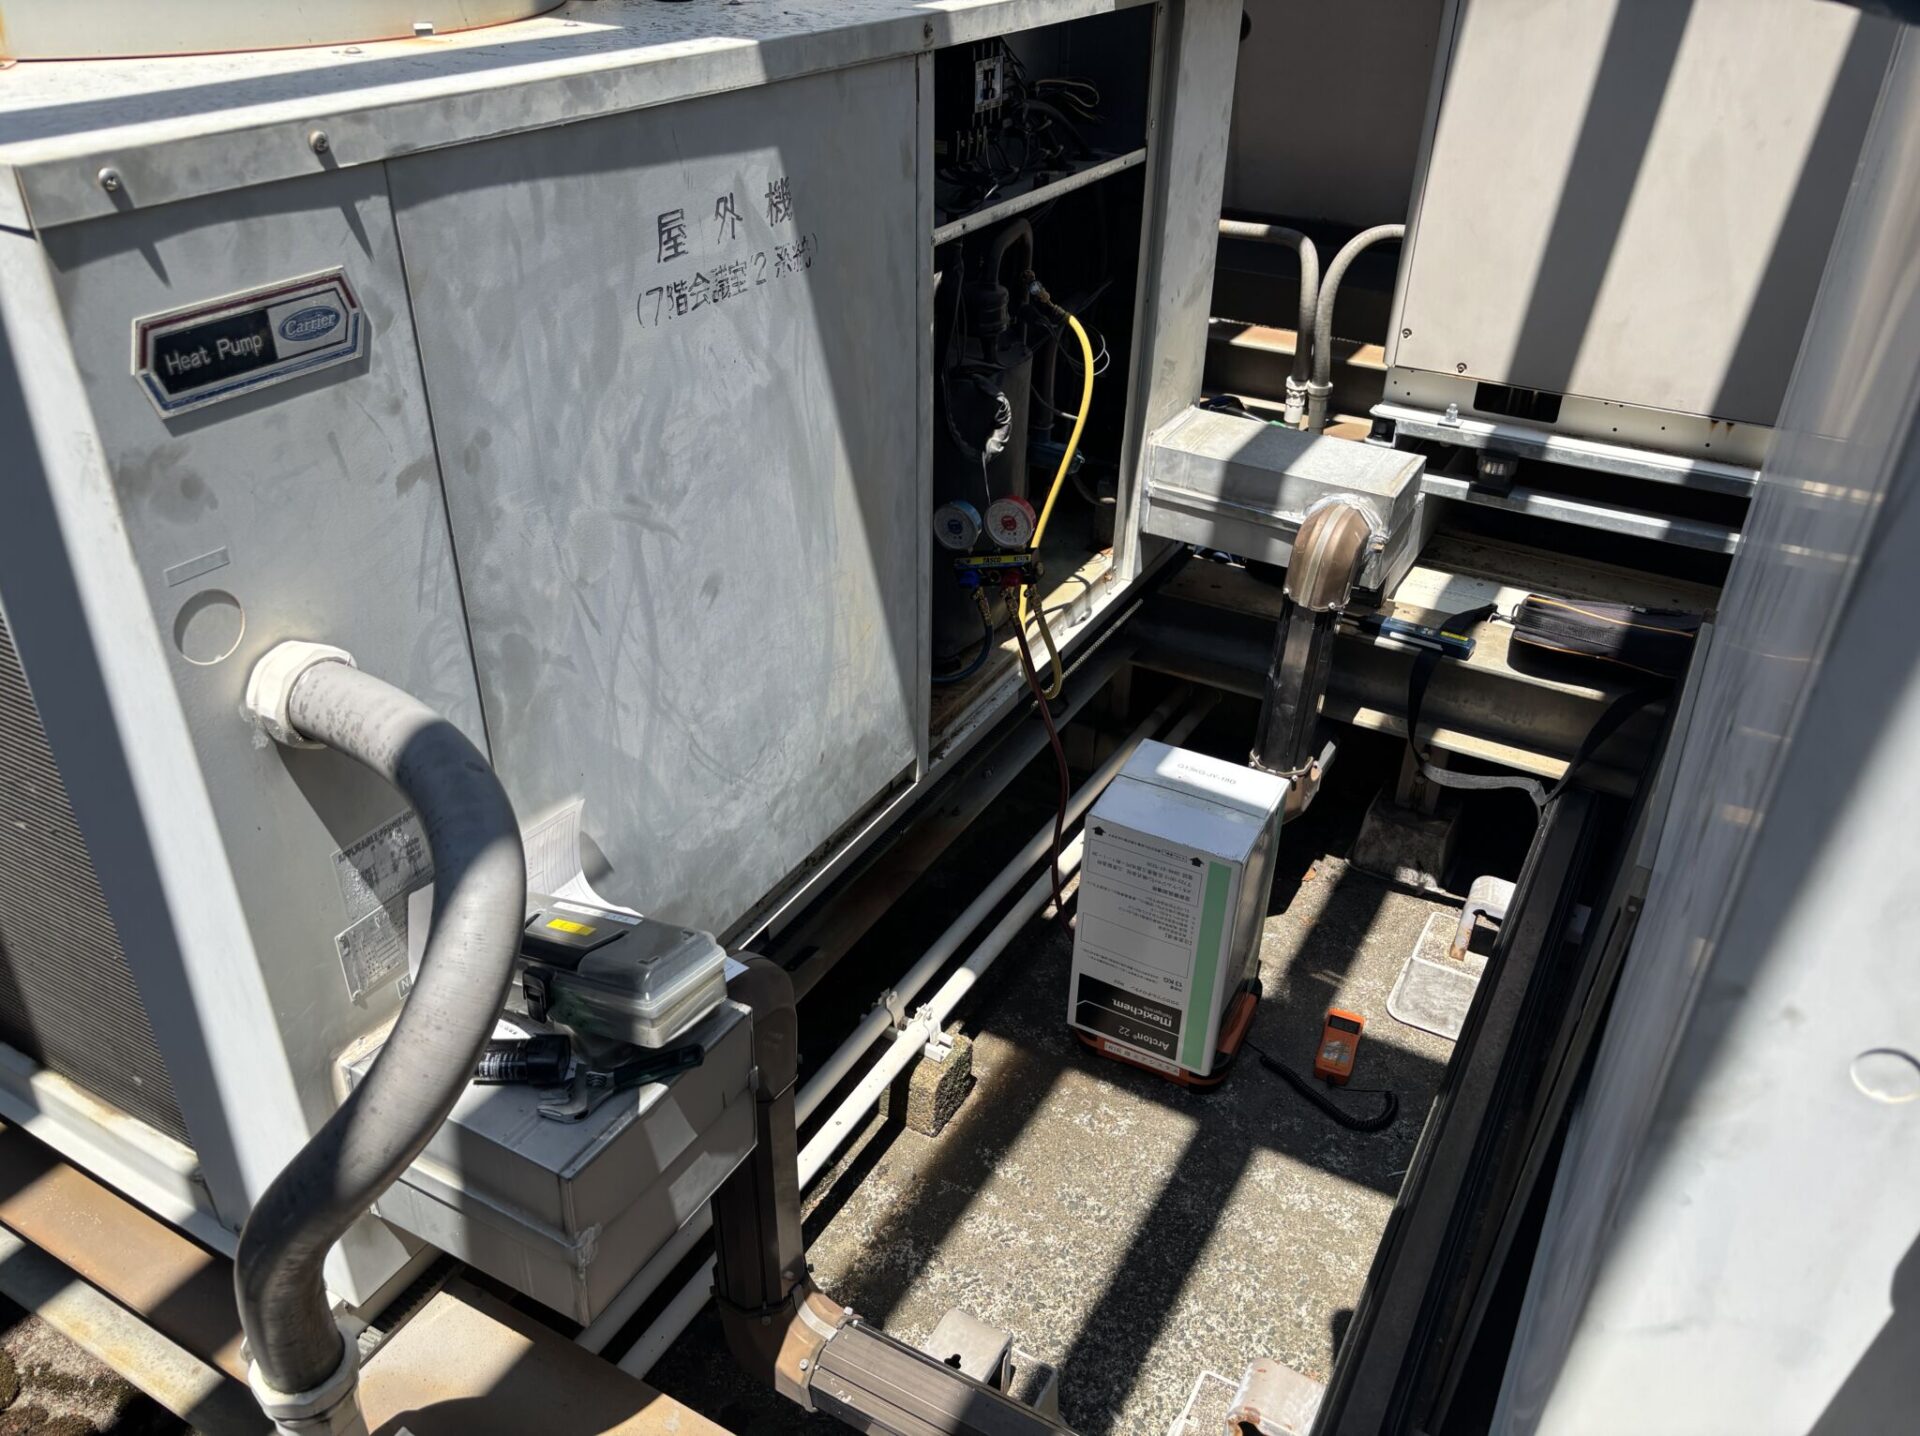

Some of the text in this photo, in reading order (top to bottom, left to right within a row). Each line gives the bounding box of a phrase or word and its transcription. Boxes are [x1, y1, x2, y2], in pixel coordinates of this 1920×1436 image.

[284, 311, 337, 336] Carrier
[164, 333, 264, 376] Heat Pump
[1118, 1025, 1131, 1037] 22
